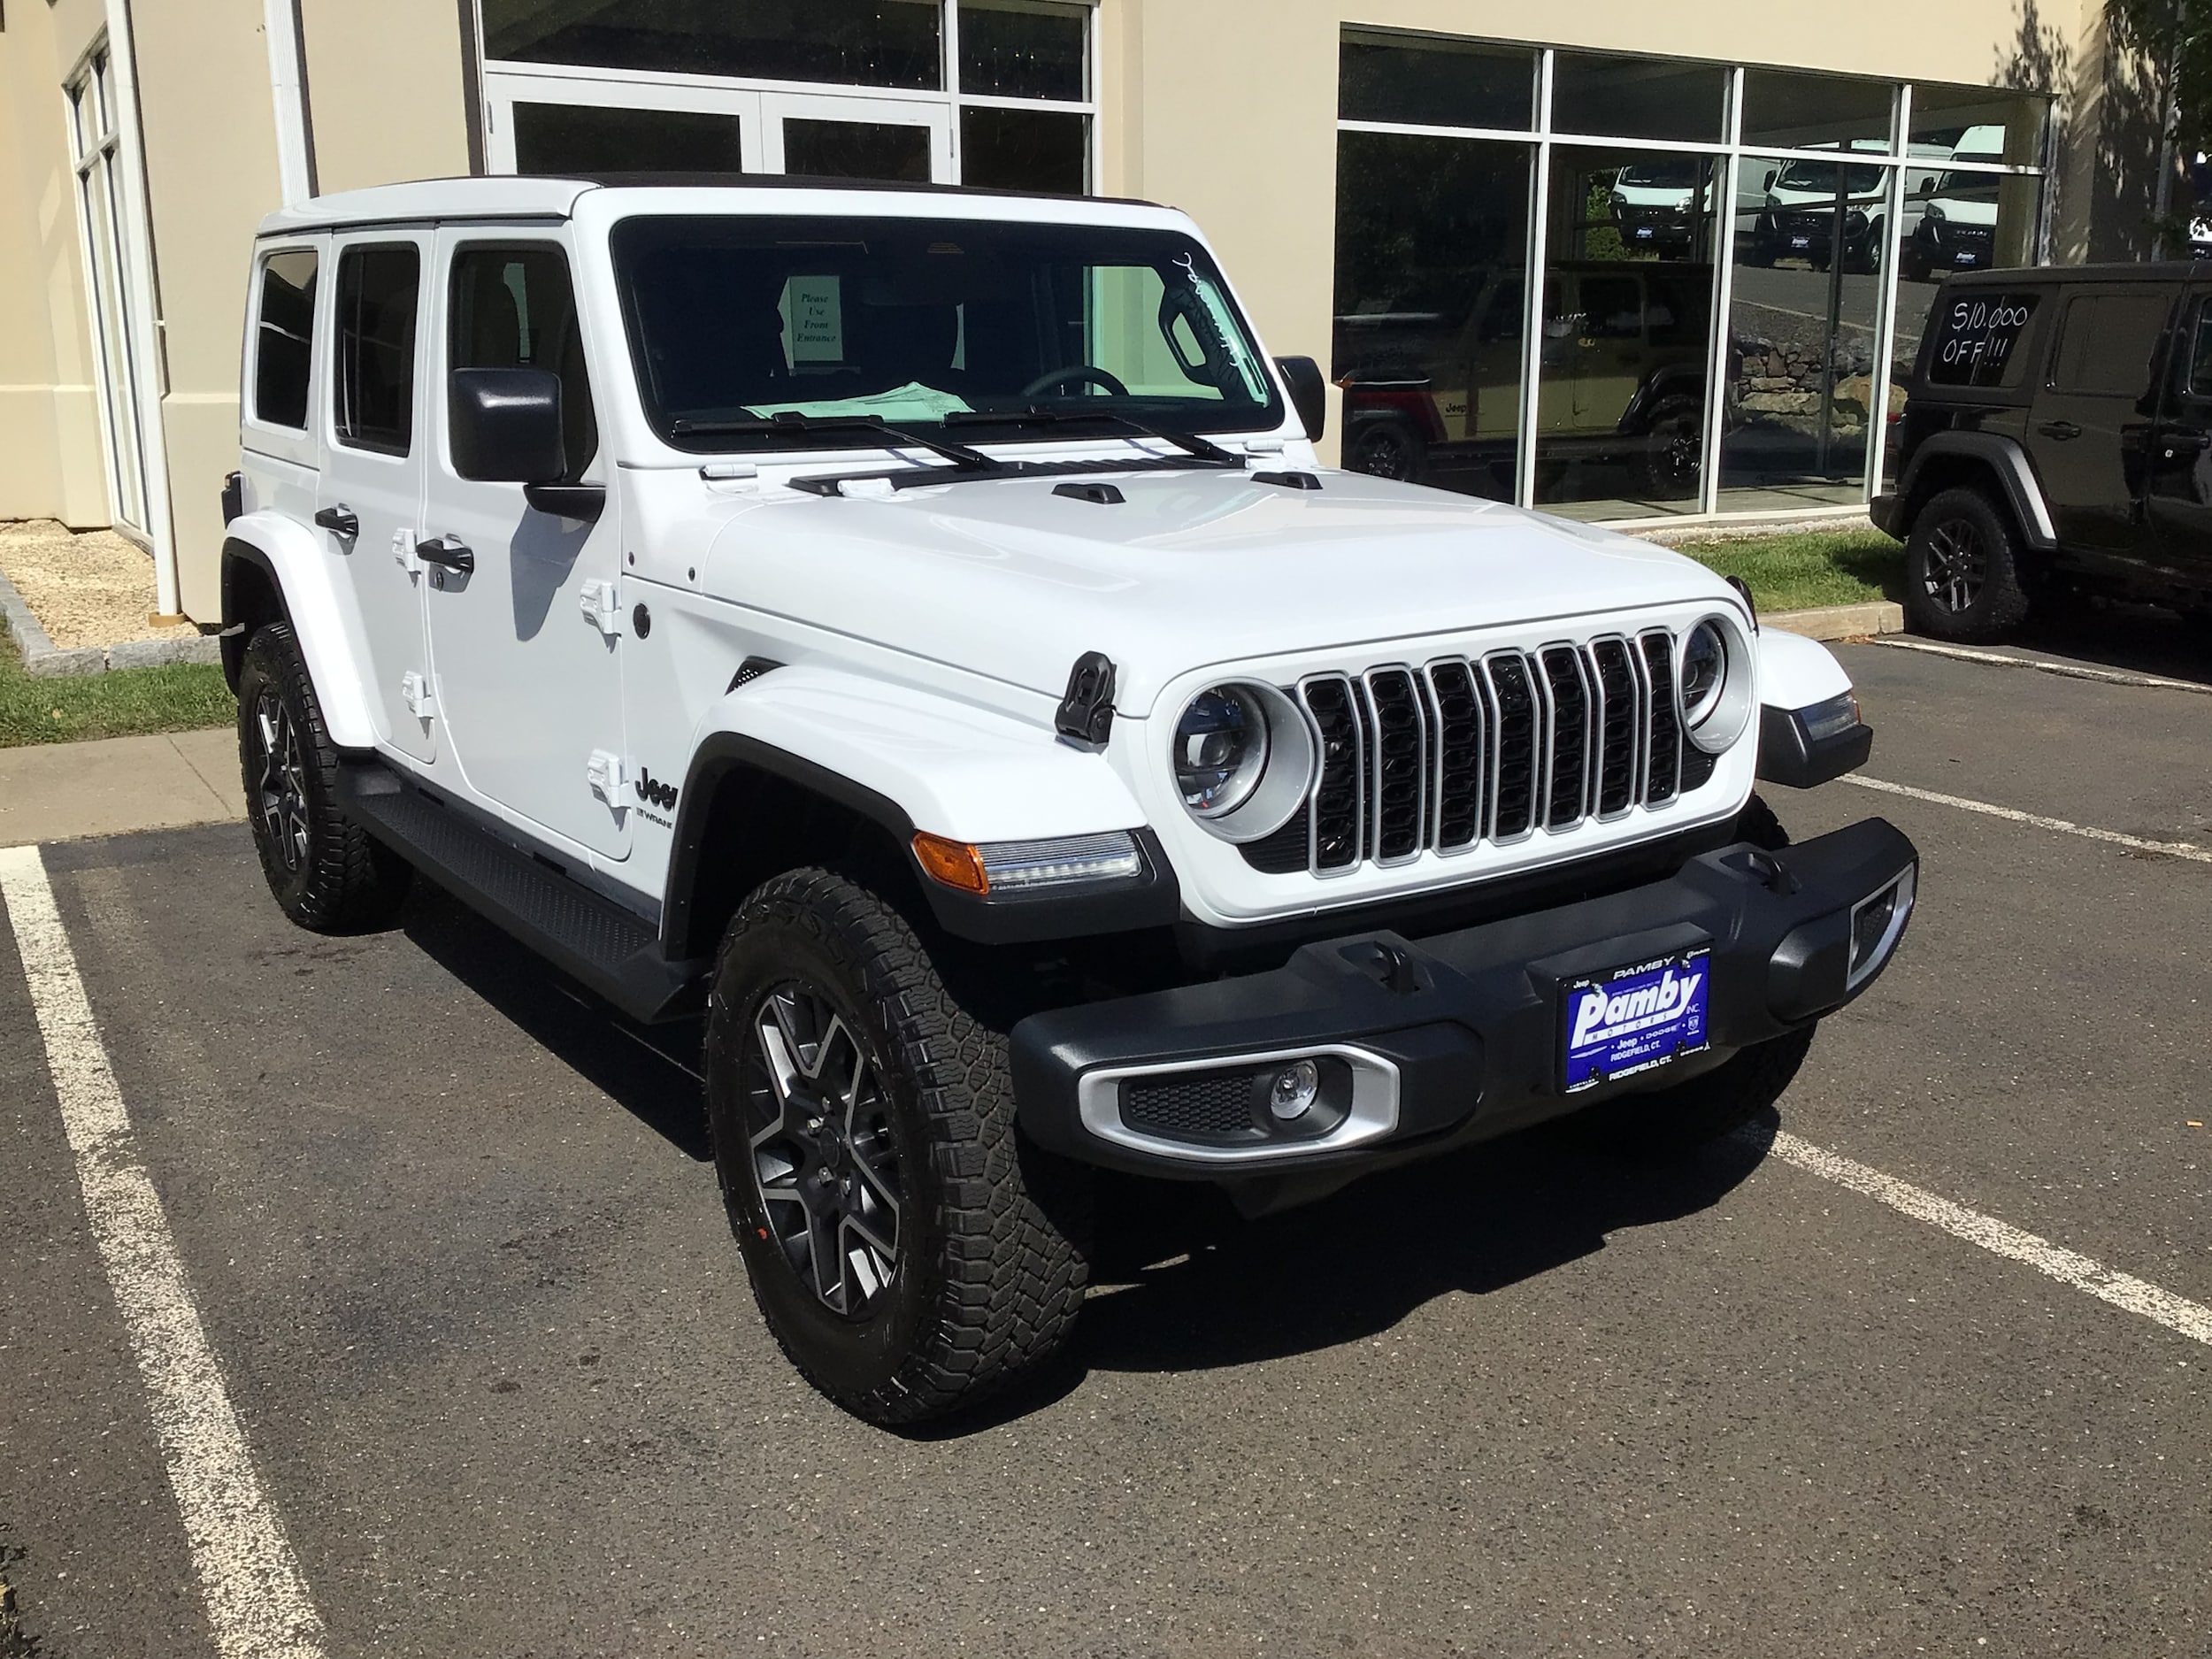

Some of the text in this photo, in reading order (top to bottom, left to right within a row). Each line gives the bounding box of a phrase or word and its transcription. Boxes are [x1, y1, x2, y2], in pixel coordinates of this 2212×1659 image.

[801, 293, 829, 303] Please
[809, 306, 825, 316] Use
[803, 319, 828, 329] Front
[796, 333, 836, 342] Entrance
[1613, 956, 1675, 979] PAMBY
[1573, 979, 1590, 989] Jeep
[1570, 970, 1702, 1050] Pamby
[1593, 1013, 1667, 1041] MOTORS
[1617, 1037, 1638, 1050] Jeep
